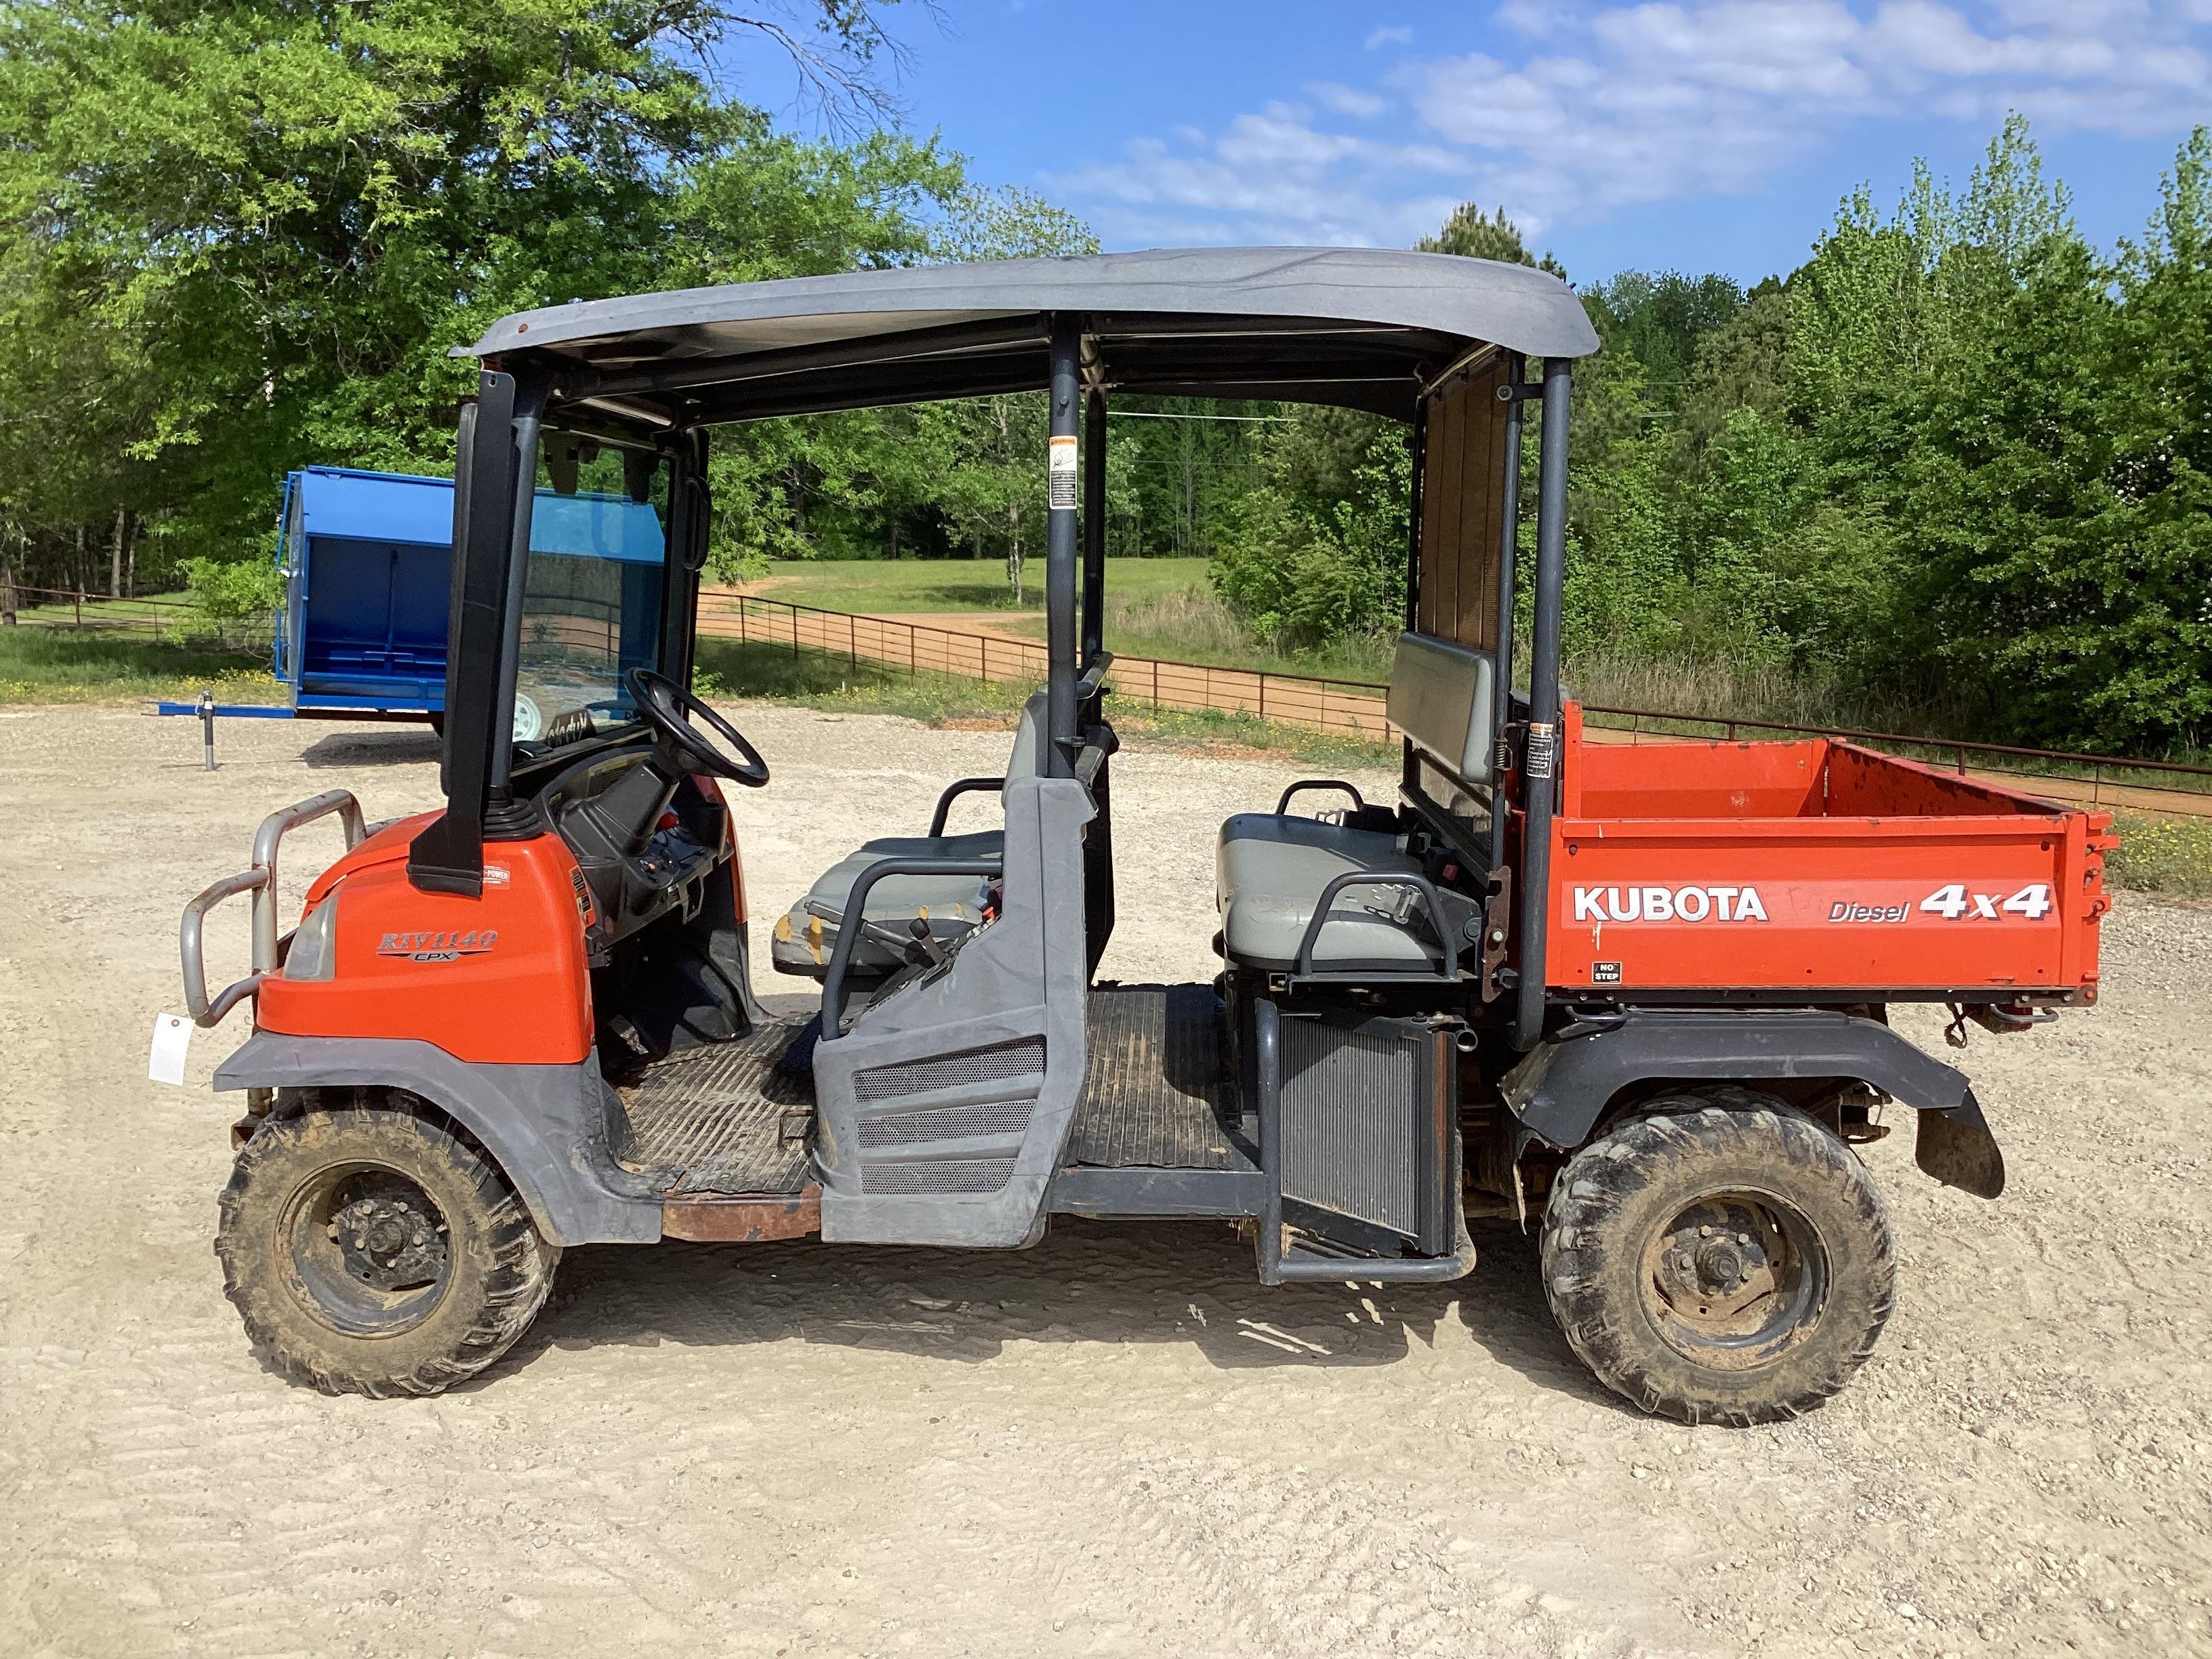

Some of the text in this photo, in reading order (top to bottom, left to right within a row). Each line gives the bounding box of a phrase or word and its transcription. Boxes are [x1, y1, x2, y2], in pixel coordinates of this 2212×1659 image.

[1573, 886, 1769, 922] KUBOTA
[1828, 884, 2053, 923] Diesel 4x4
[377, 930, 499, 949] RTV1140
[415, 952, 453, 961] CPX
